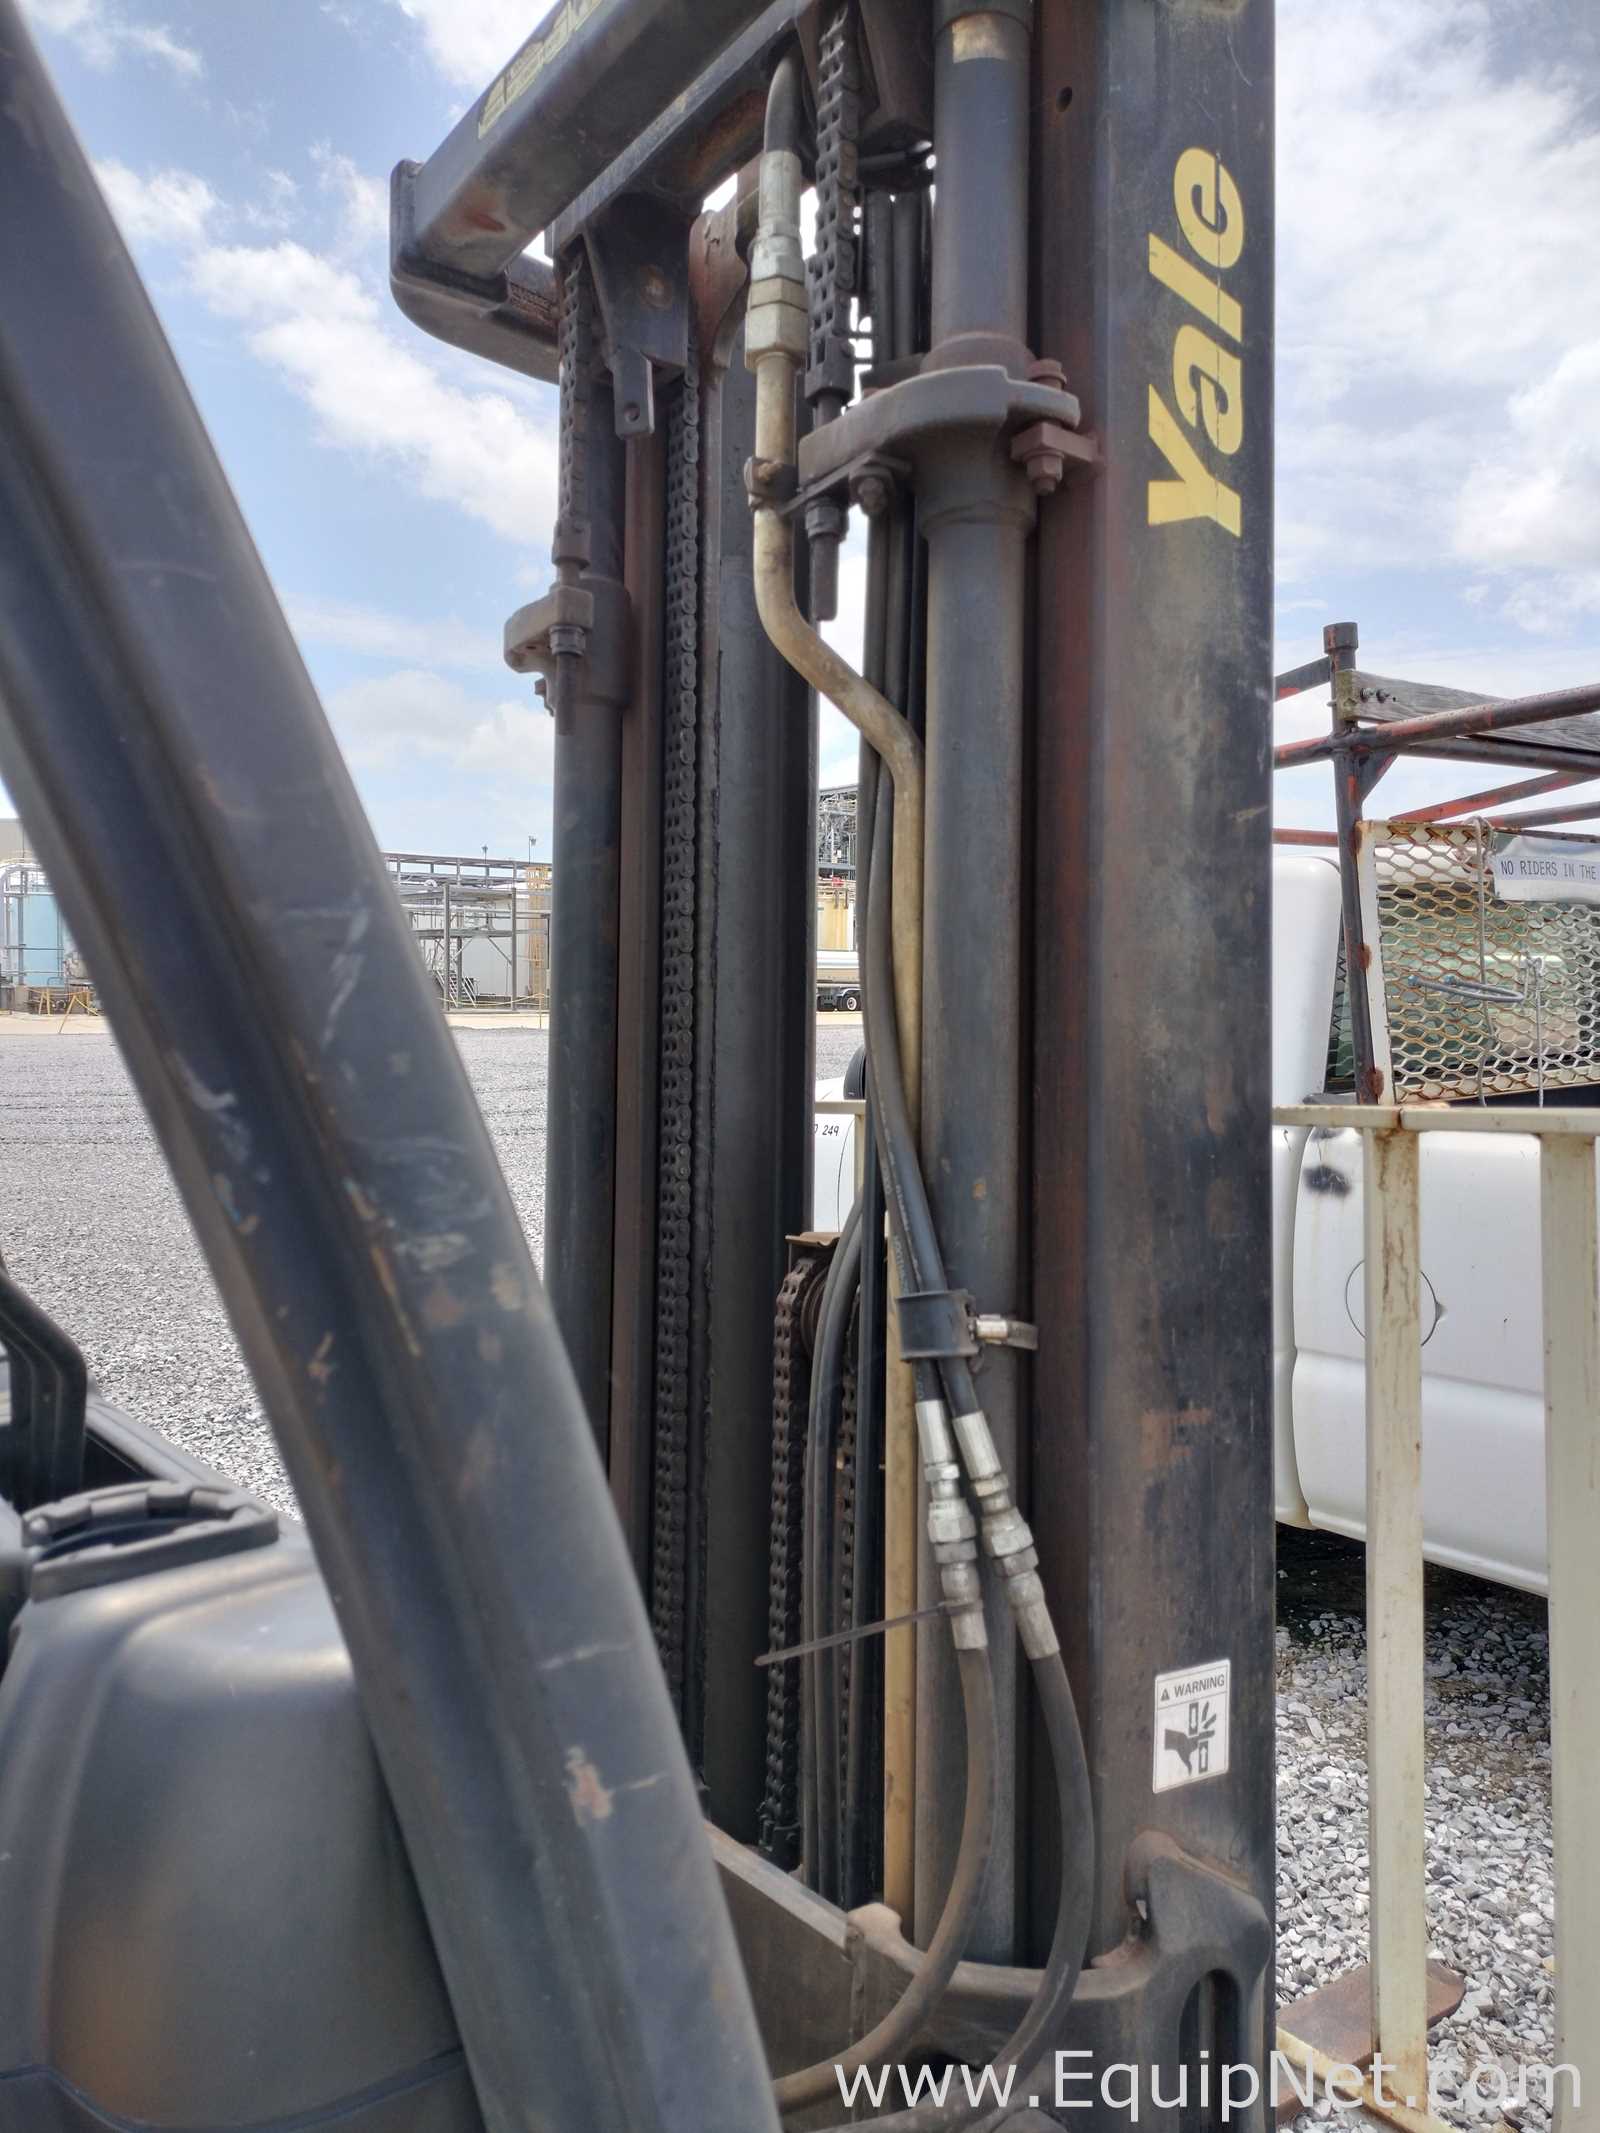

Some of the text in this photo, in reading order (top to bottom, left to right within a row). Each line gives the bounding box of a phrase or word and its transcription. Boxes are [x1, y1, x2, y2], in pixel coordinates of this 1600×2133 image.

[1148, 147, 1244, 538] Yale
[1500, 860, 1596, 880] NO RIDERS IN THE
[822, 1124, 840, 1137] 249
[1173, 1674, 1225, 1698] WARNING
